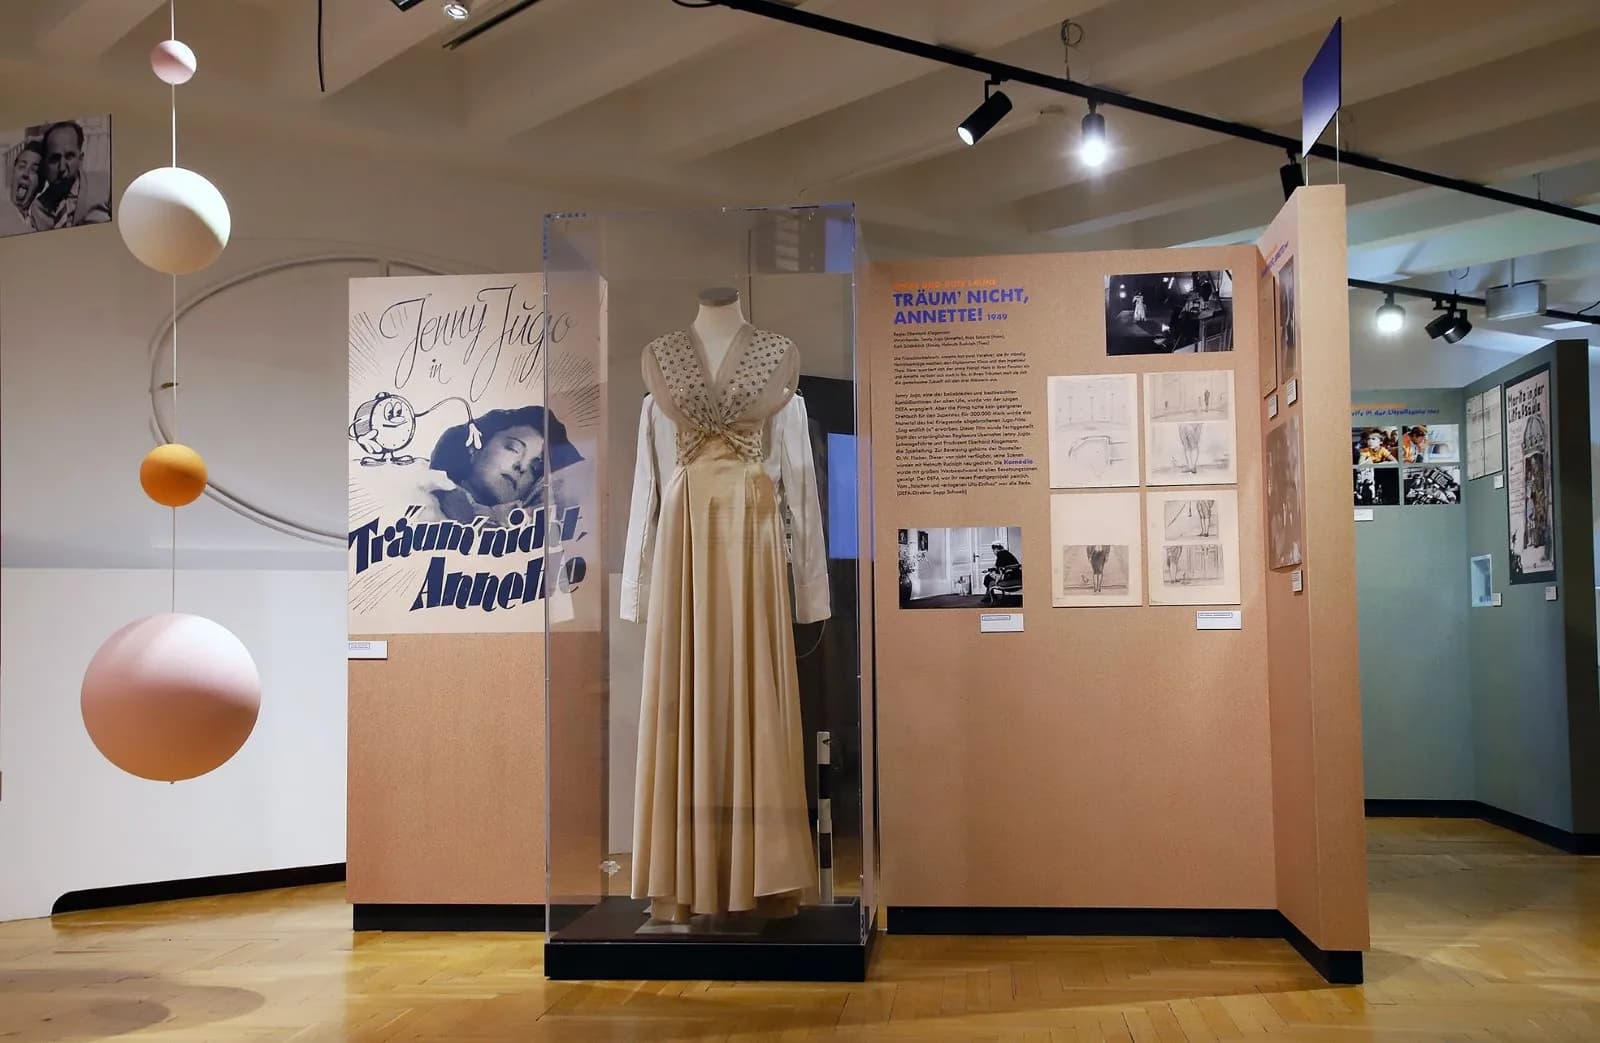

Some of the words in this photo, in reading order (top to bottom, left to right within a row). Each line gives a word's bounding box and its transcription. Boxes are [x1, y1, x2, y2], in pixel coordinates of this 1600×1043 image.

[967, 288, 1029, 304] NICHT,
[894, 308, 983, 325] ANNETTE!
[987, 312, 1008, 321] 1949
[379, 293, 487, 390] Jenny
[429, 358, 451, 385] in
[409, 555, 587, 613] Annette
